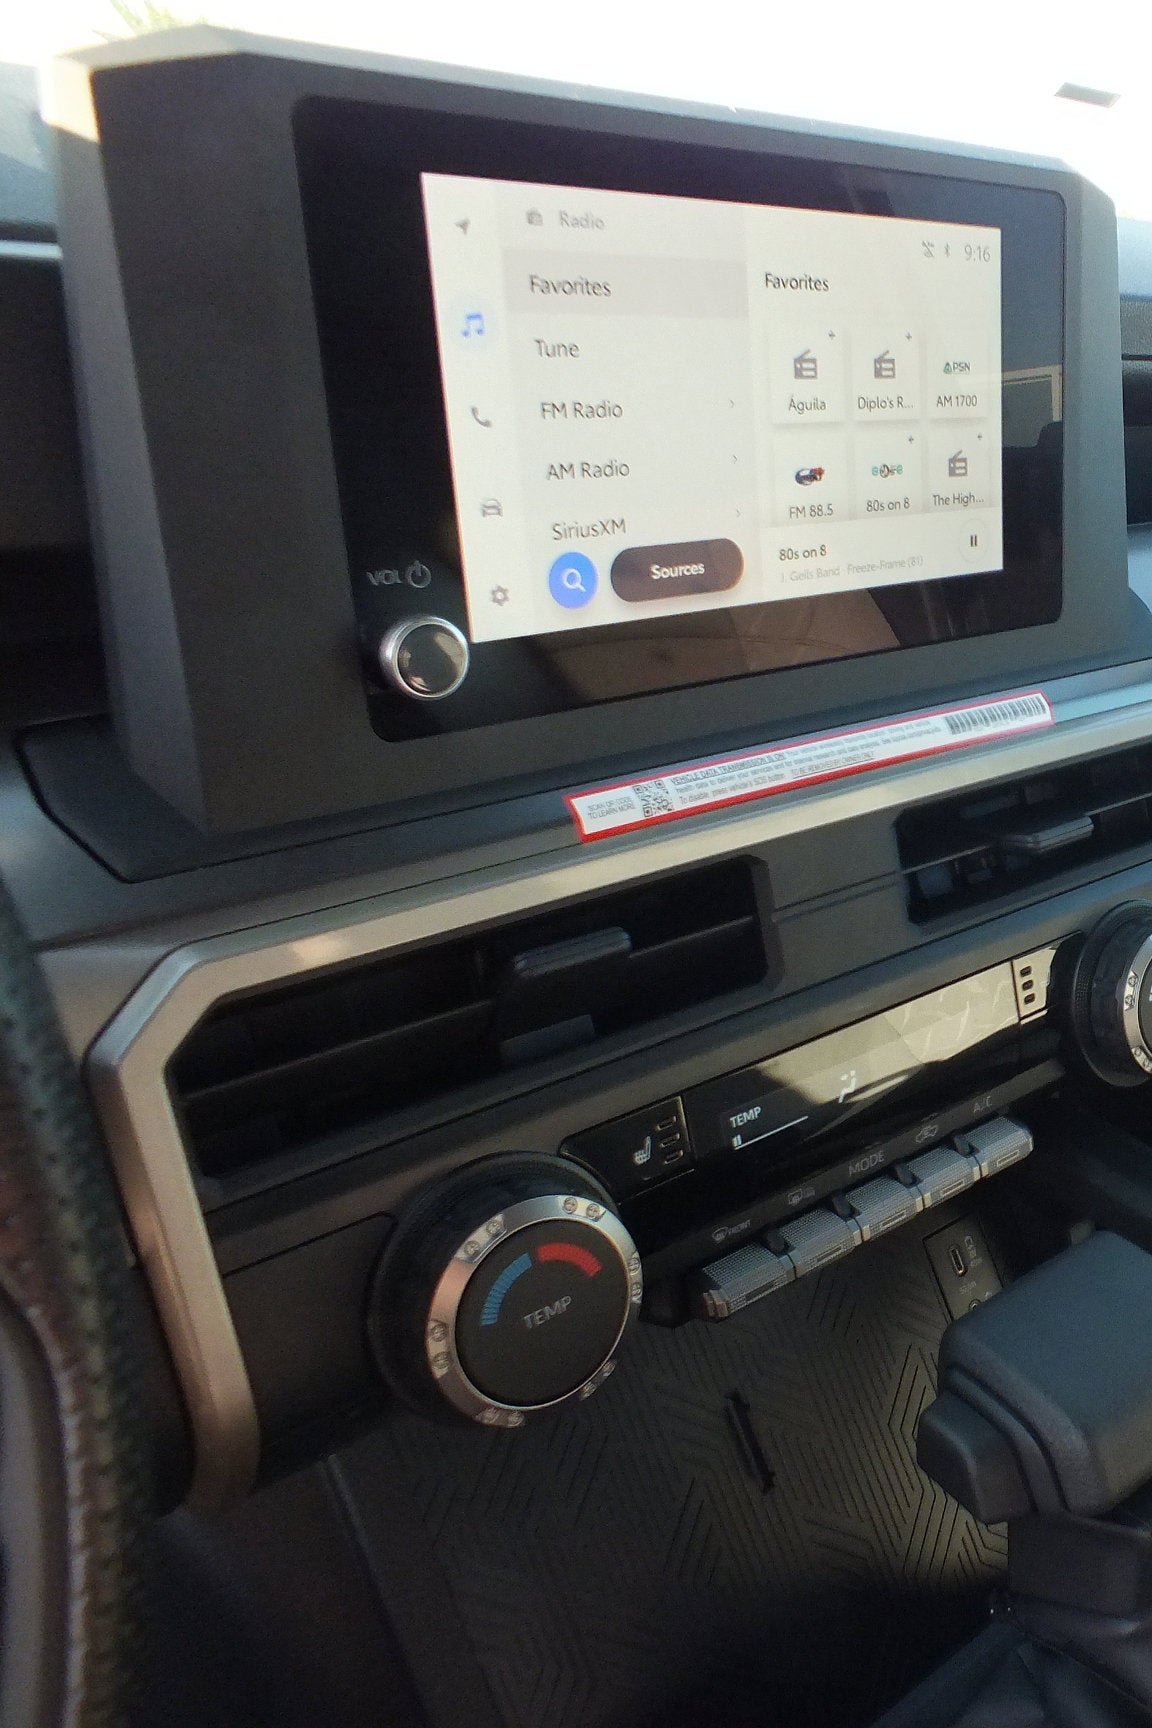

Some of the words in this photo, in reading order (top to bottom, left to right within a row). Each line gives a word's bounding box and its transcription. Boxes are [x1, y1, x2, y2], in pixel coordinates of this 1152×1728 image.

[559, 210, 604, 230] Radio
[964, 244, 991, 262] 9:16
[529, 273, 611, 298] Favorites
[765, 273, 829, 292] Favorites
[534, 339, 580, 358] Tune
[541, 401, 568, 420] FM
[573, 400, 623, 419] Radio
[788, 395, 826, 415] Águila
[857, 396, 895, 412] Diplo's
[936, 396, 953, 407] AM
[955, 395, 978, 407] 1700
[547, 463, 575, 480] AM
[581, 460, 630, 479] Radio
[866, 500, 885, 512] 80s
[887, 500, 901, 511] on
[903, 498, 911, 509] 8
[933, 494, 950, 506] The
[789, 506, 806, 519] FM
[809, 503, 834, 518] 88.5
[552, 518, 627, 541] SiriusXM
[779, 548, 800, 561] 80s
[802, 549, 818, 559] on
[820, 545, 827, 557] 8
[651, 562, 705, 580] Sources
[846, 559, 906, 575] Freeze-Frame
[366, 570, 403, 586] VOL
[730, 1106, 761, 1128] TEMP
[849, 1151, 885, 1175] MODE
[523, 1295, 572, 1329] TEMP
